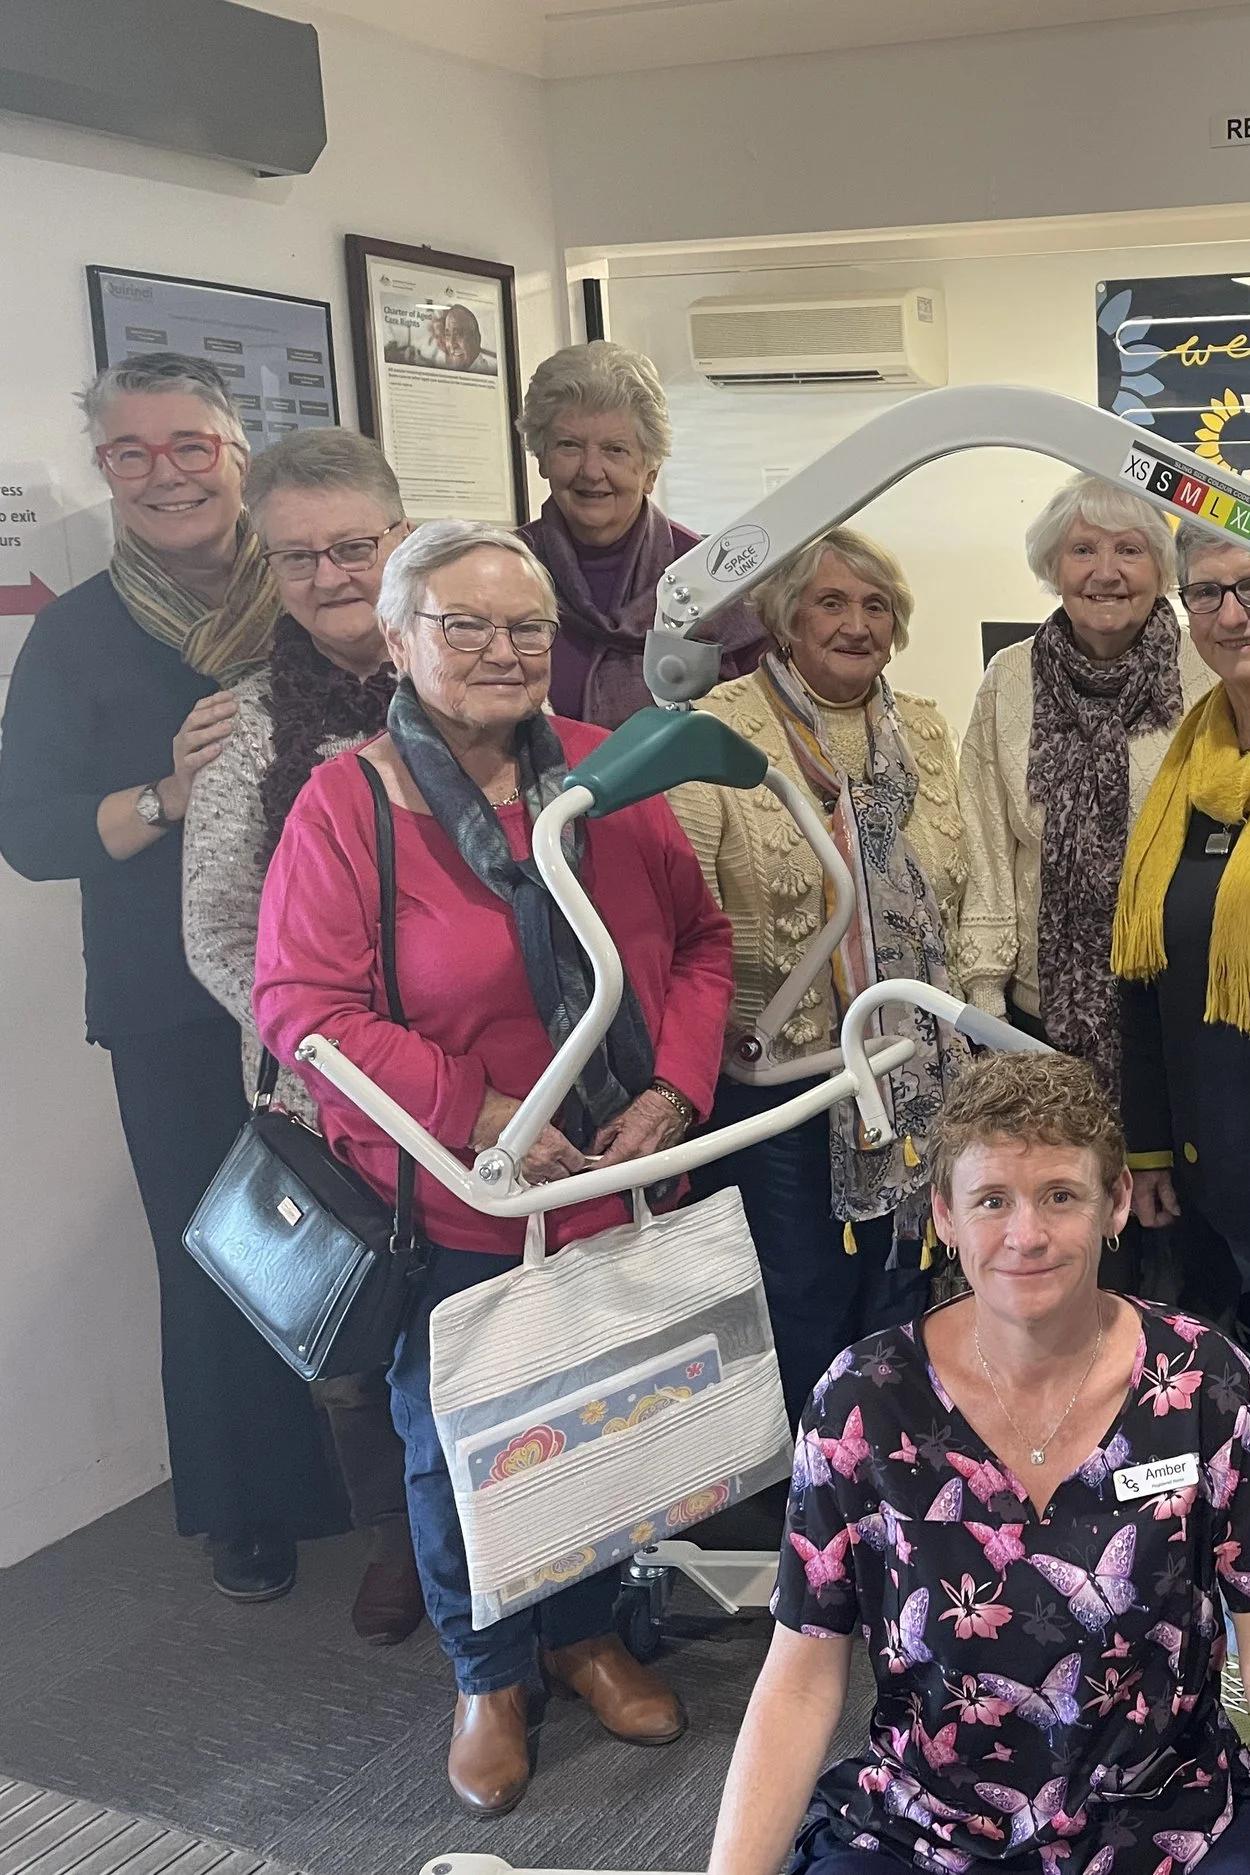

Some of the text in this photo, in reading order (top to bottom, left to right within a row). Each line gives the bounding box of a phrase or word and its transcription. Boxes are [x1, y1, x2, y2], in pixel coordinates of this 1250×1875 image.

[0, 486, 23, 496] ess
[1174, 462, 1250, 502] SLING SIZE COLOUR CODE
[1124, 455, 1150, 481] XS
[1156, 471, 1172, 492] S
[1180, 482, 1201, 507] M
[1209, 497, 1219, 518] L
[1230, 506, 1250, 533] XL
[11, 509, 37, 522] exit
[724, 545, 756, 573] SPACE
[734, 558, 758, 577] LINK
[1146, 1462, 1186, 1480] Amber
